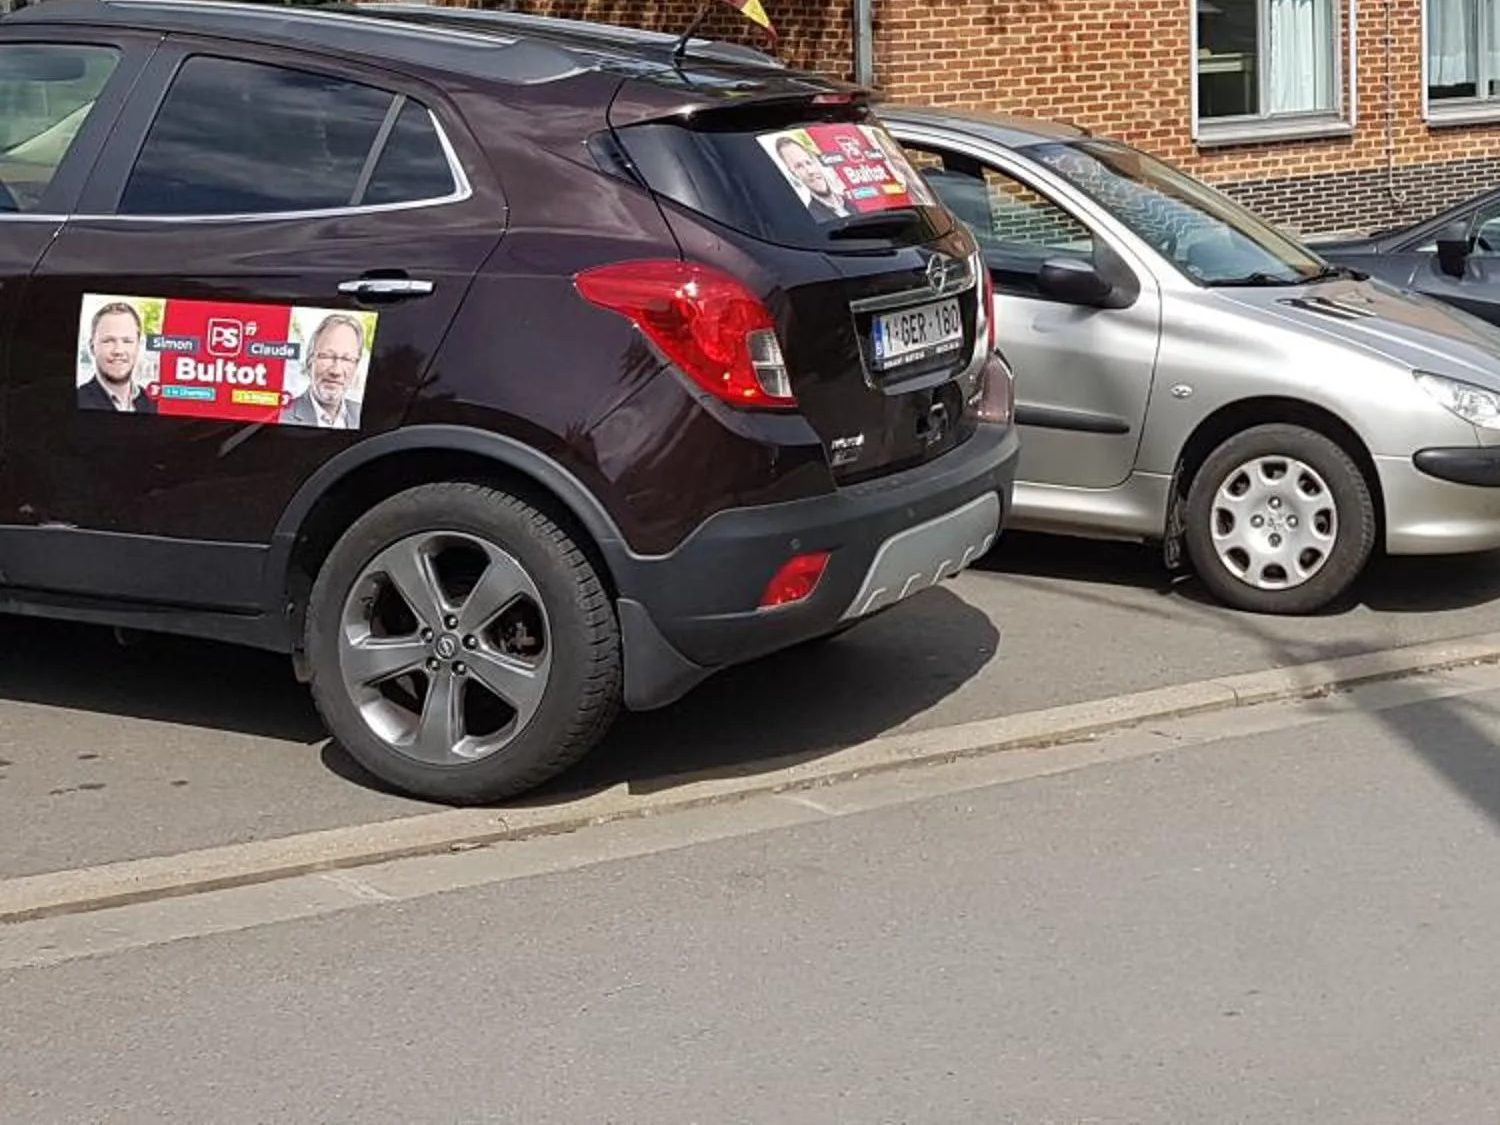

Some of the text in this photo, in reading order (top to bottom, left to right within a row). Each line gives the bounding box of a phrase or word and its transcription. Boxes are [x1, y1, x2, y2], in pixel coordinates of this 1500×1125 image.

[153, 337, 193, 350] Simon
[211, 327, 239, 348] PS
[251, 343, 295, 356] Claude
[175, 356, 267, 386] Bultot
